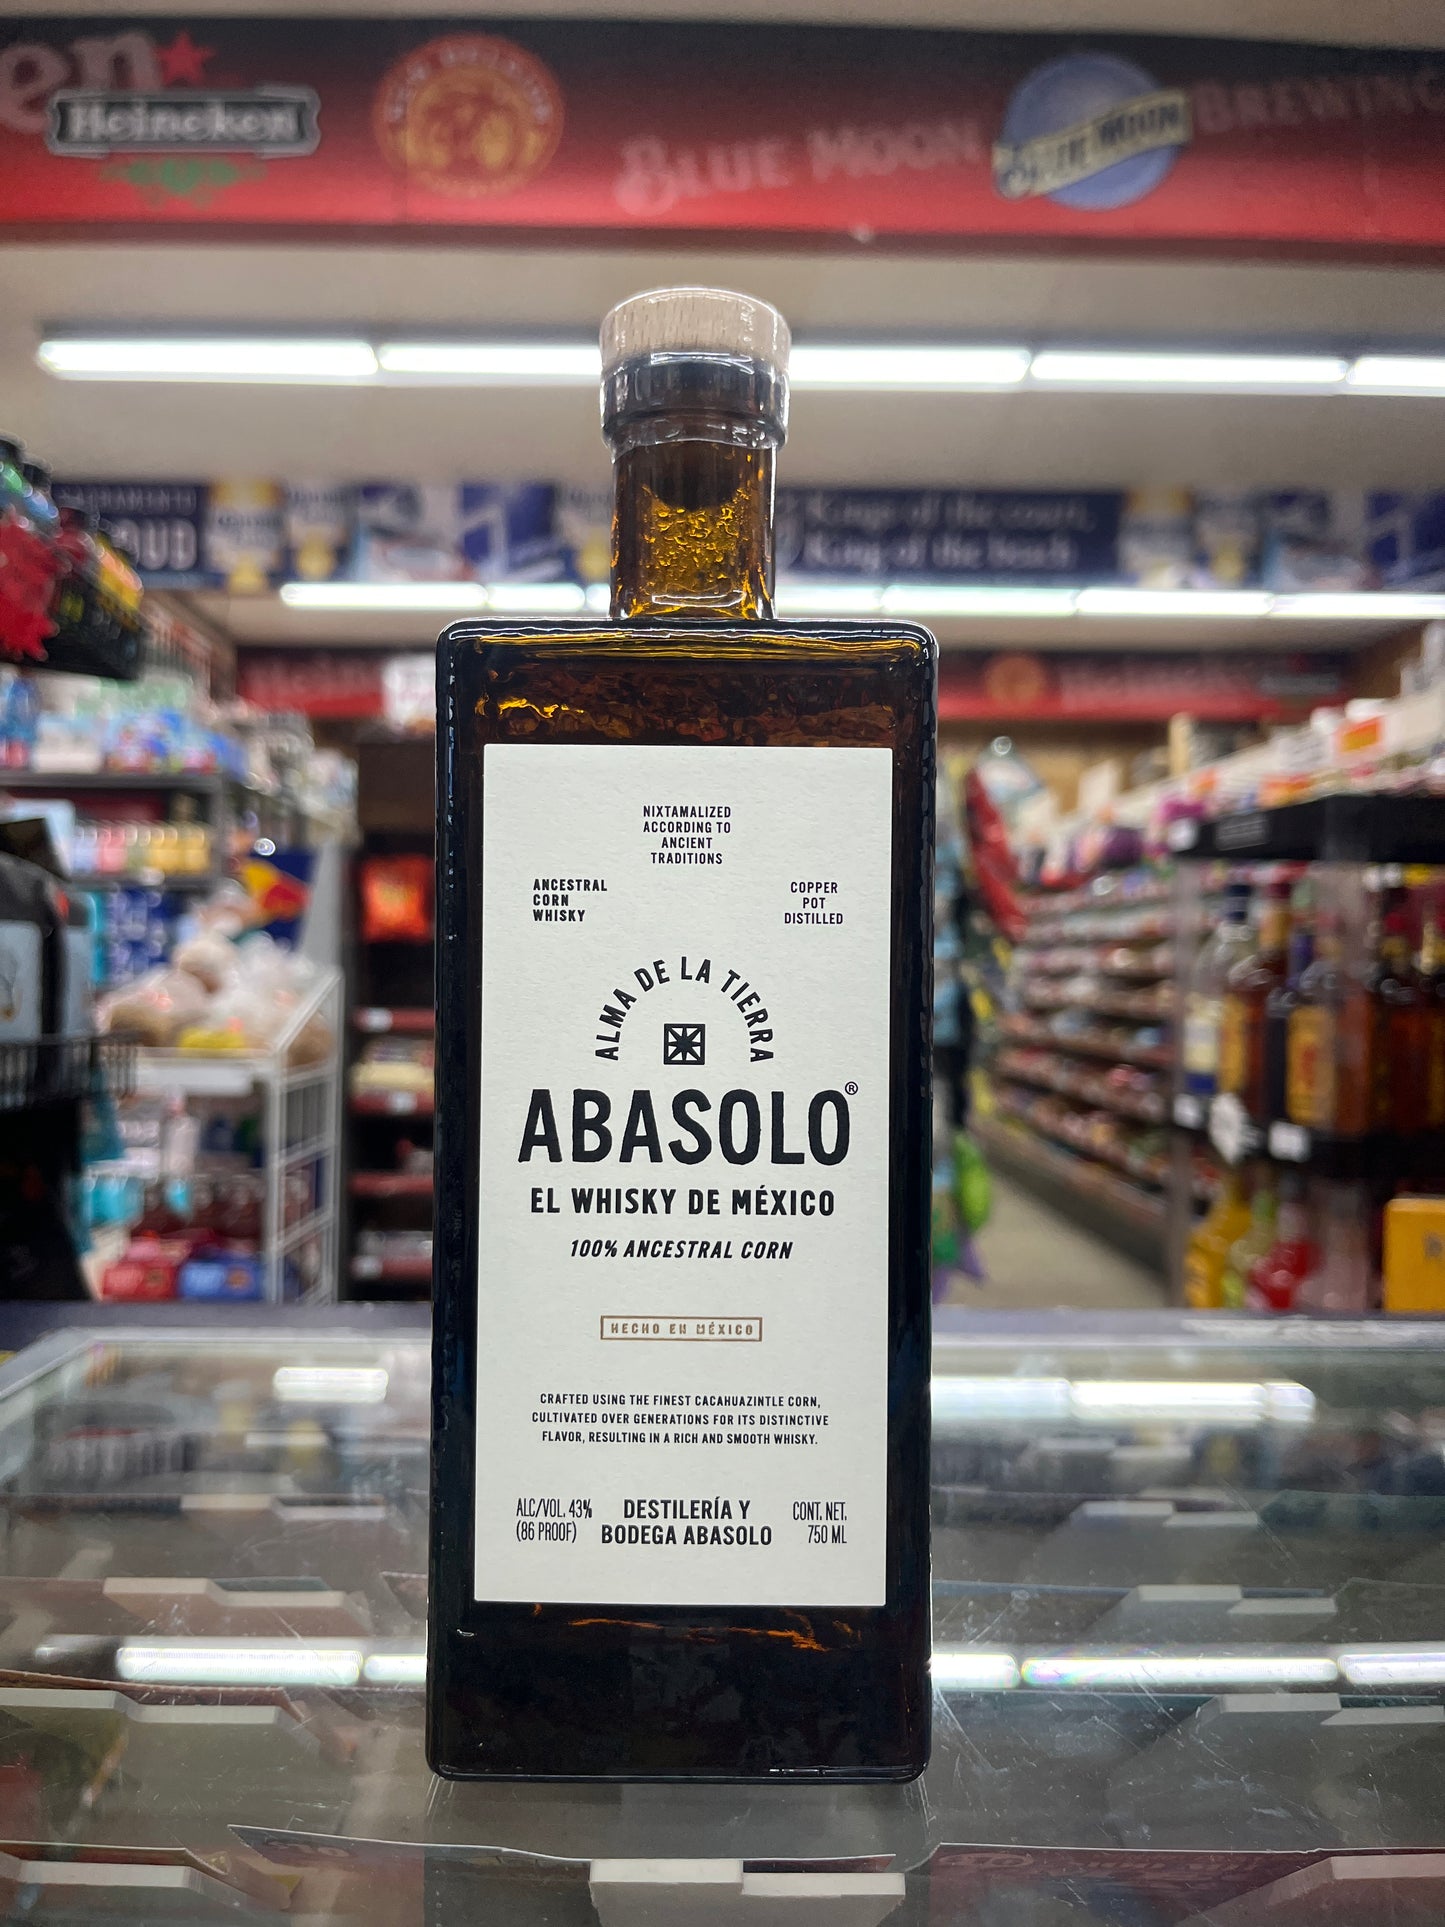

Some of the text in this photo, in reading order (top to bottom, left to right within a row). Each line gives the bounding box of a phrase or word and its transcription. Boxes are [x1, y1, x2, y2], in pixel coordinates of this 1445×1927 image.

[68, 93, 298, 143] Heineken
[613, 120, 984, 217] BLUE MOON
[644, 806, 730, 817] NIXTAMALIZED
[643, 821, 730, 833] ACCORDING TO
[662, 837, 712, 848] ANCIENT
[651, 853, 722, 864] TRADITIONS
[533, 879, 607, 891] ANCESTRAL
[791, 882, 837, 893] COPPER
[533, 894, 568, 906] CORN
[803, 898, 825, 909] POT
[533, 909, 585, 921] WHISKY
[785, 913, 843, 924] DISTILLED
[595, 957, 773, 1062] ALMA DE LA TIERRA
[531, 1185, 834, 1216] EL WHISKY DE MÉXICO
[571, 1240, 793, 1259] 100% ANCESTRAL CORN
[611, 1322, 753, 1335] HECHO EN MÉXICO
[541, 1394, 820, 1408] CRAFTED USING THE FINEST CACAHUAZINTLE CORN,
[532, 1412, 828, 1425] CULTIVATED OVER GENERATIONS FOR ITS DISTINCTIVE
[543, 1431, 817, 1444] FLAVOR, RESULTING IN A RICH AND SMOOTH WHISKY.
[516, 1498, 592, 1519] ALC/VOL. 43%
[624, 1497, 750, 1519] DESTILERÍA Y
[793, 1502, 847, 1520] CONT. NET.
[517, 1521, 576, 1543] (86 PROOF)
[602, 1525, 771, 1545] BODEGA ABASOLO
[808, 1525, 847, 1543] 750 ML
